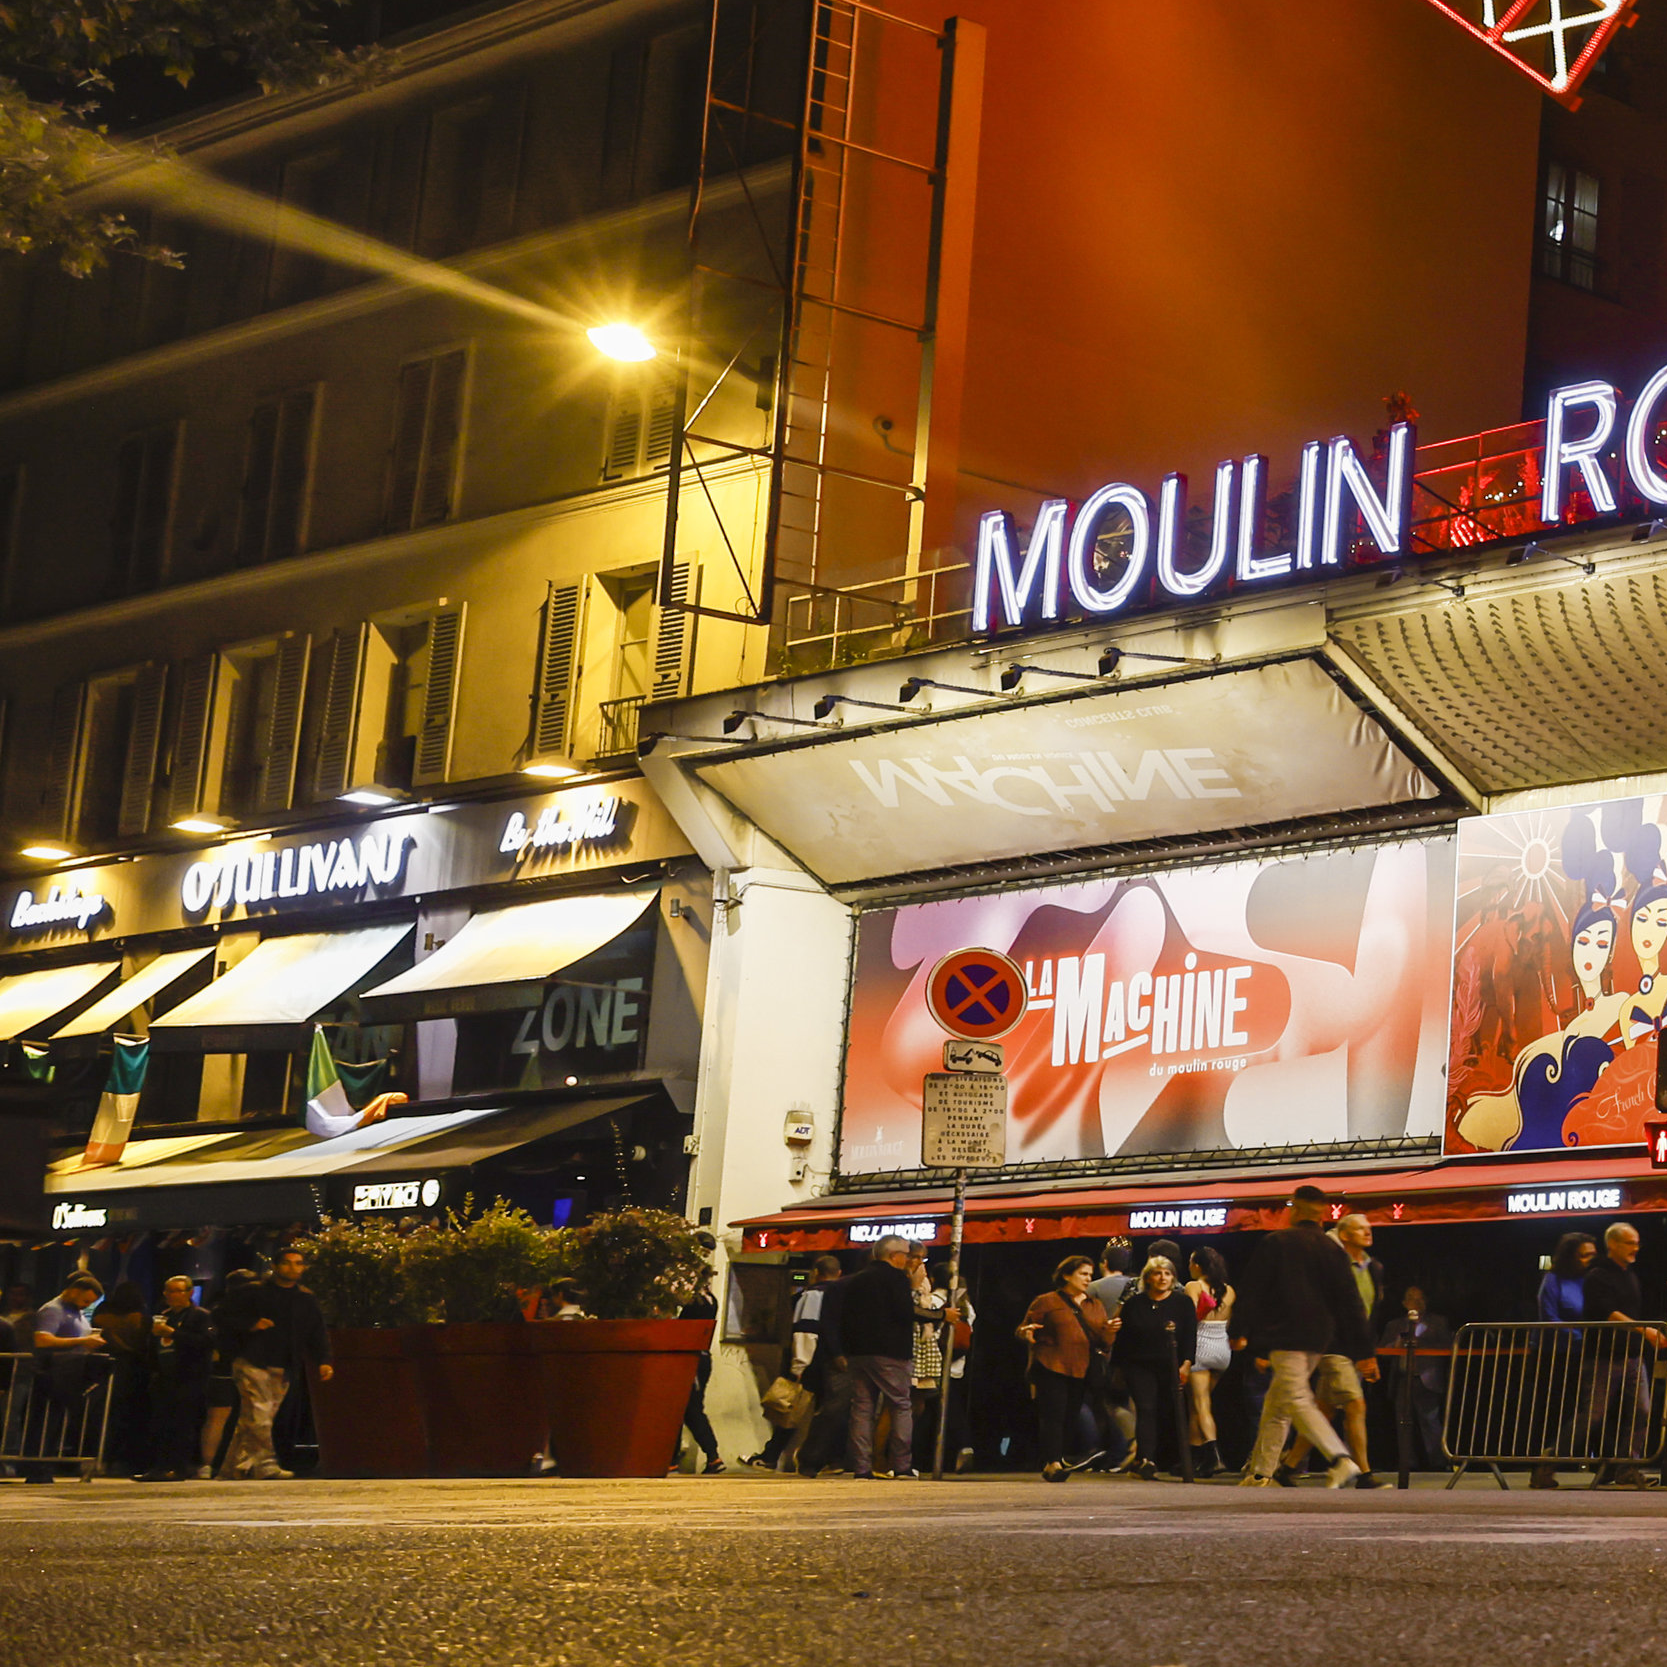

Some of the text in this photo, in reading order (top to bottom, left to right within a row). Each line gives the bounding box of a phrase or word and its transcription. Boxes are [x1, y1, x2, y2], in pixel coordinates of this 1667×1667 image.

[972, 421, 1416, 633] MOULIN
[1025, 958, 1053, 998] LA
[1149, 1057, 1248, 1077] du moulin rouge
[1507, 1188, 1621, 1213] MOULIN ROUGE
[1129, 1208, 1227, 1229] MOULIN ROUGE
